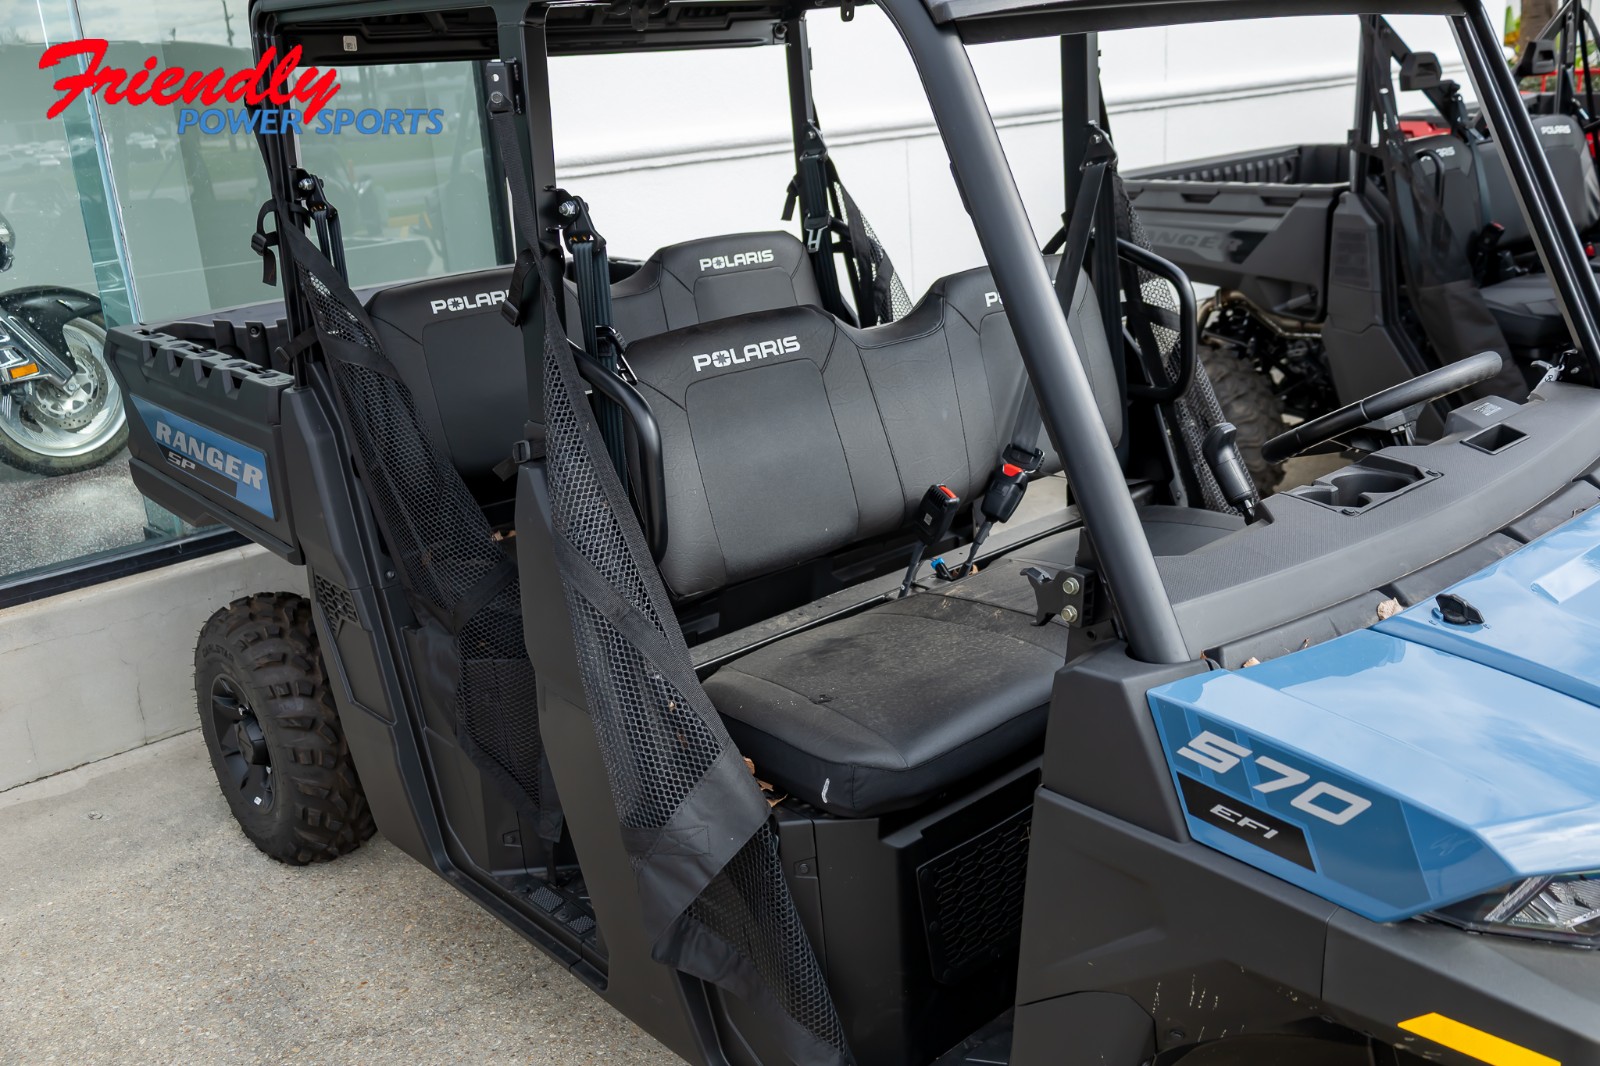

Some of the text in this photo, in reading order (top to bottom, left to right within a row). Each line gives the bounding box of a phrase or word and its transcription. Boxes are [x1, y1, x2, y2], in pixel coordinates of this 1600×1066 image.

[699, 249, 775, 272] POLARIS
[430, 289, 510, 315] POLAR
[692, 335, 801, 372] POLARIS
[156, 420, 263, 490] RANGER
[167, 451, 196, 470] SP
[1176, 730, 1373, 826] 570
[1209, 804, 1279, 840] EFI
